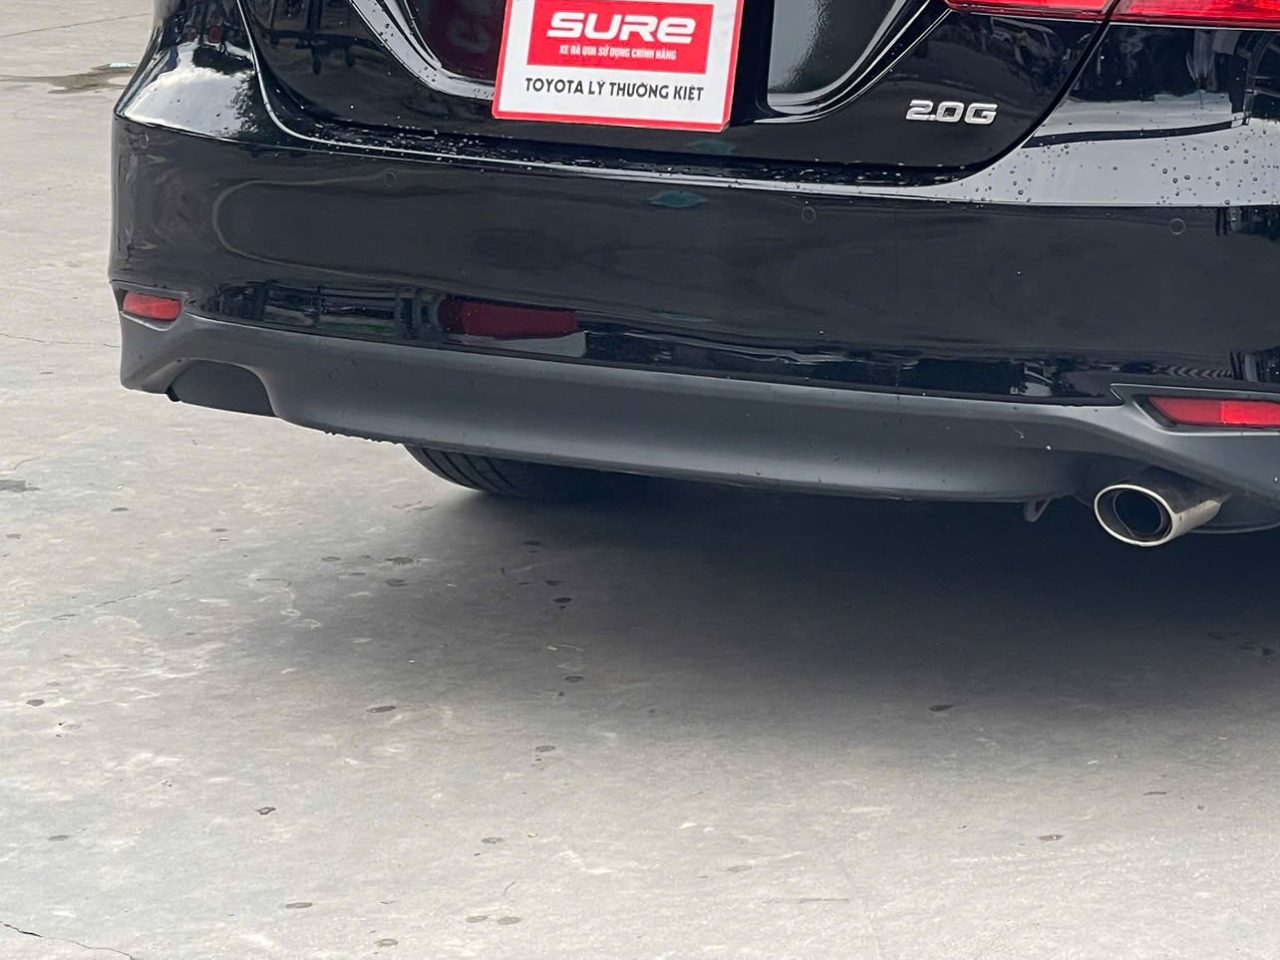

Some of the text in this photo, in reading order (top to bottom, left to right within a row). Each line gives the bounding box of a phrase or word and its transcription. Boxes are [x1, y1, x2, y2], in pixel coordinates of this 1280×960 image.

[559, 44, 569, 55] XE
[525, 77, 584, 95] TOYOTA
[588, 79, 606, 95] LÝ
